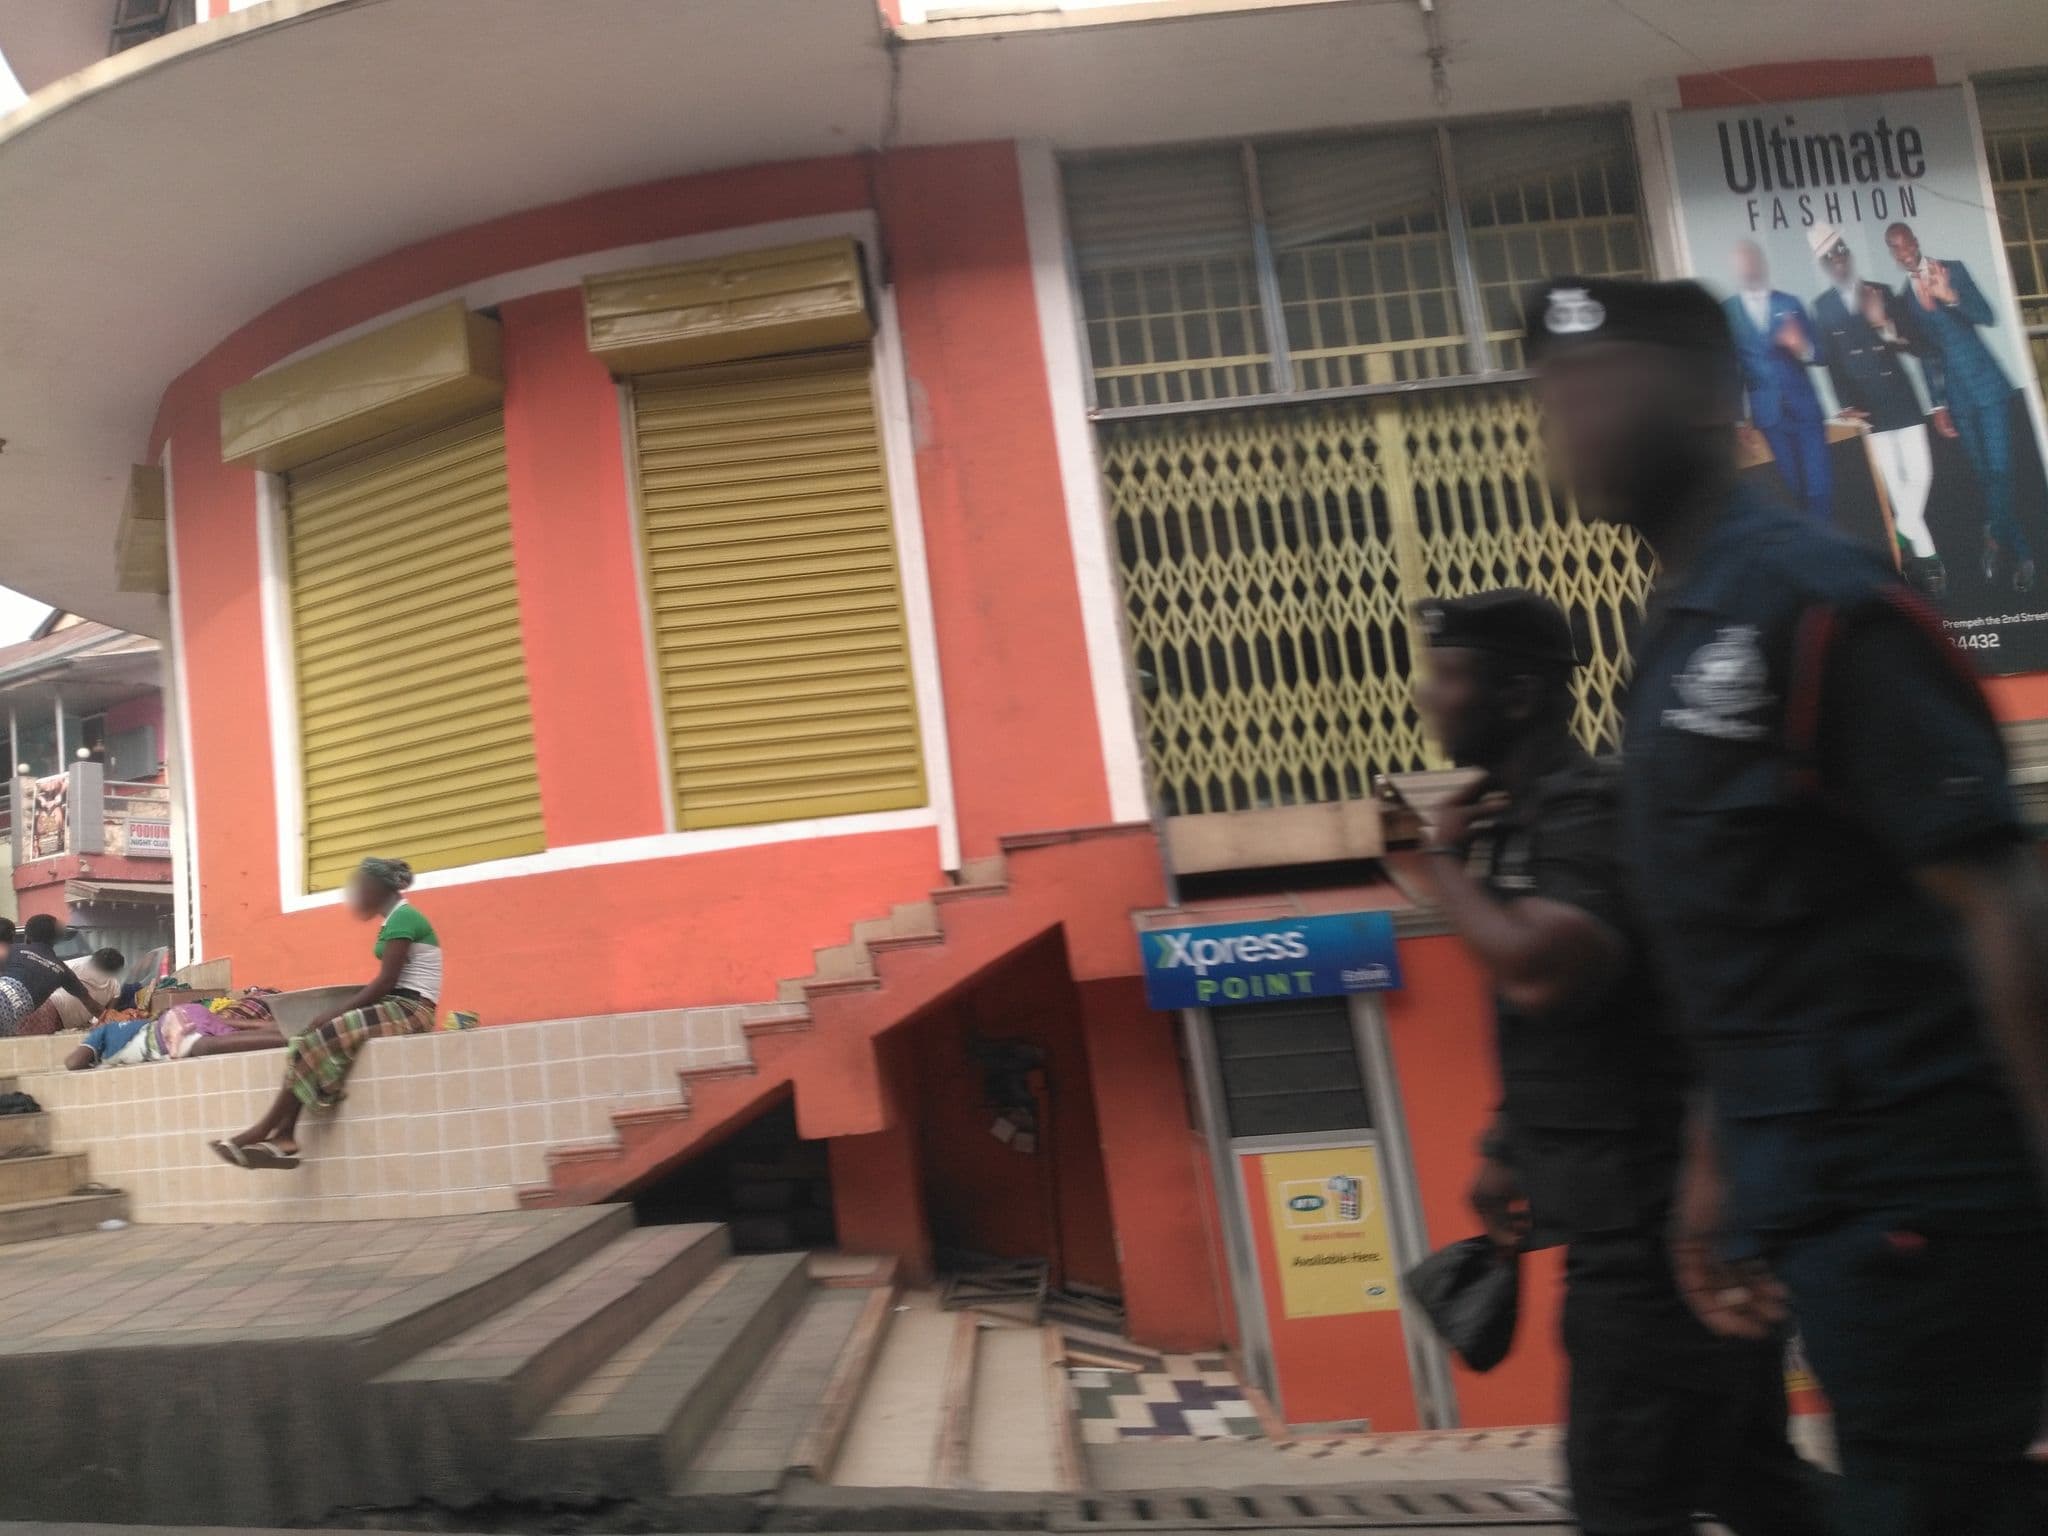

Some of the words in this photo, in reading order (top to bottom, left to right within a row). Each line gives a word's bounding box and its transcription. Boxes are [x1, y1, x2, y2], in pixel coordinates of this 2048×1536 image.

[1717, 114, 1925, 194] Ultimate
[1747, 185, 1918, 232] FASHION
[1942, 617, 1985, 629] Prempeh
[1985, 616, 2000, 625] the
[2001, 613, 2020, 624] 2nd
[130, 824, 170, 839] PODIUM
[1155, 931, 1309, 976] Xpress
[1197, 971, 1314, 1001] POINT
